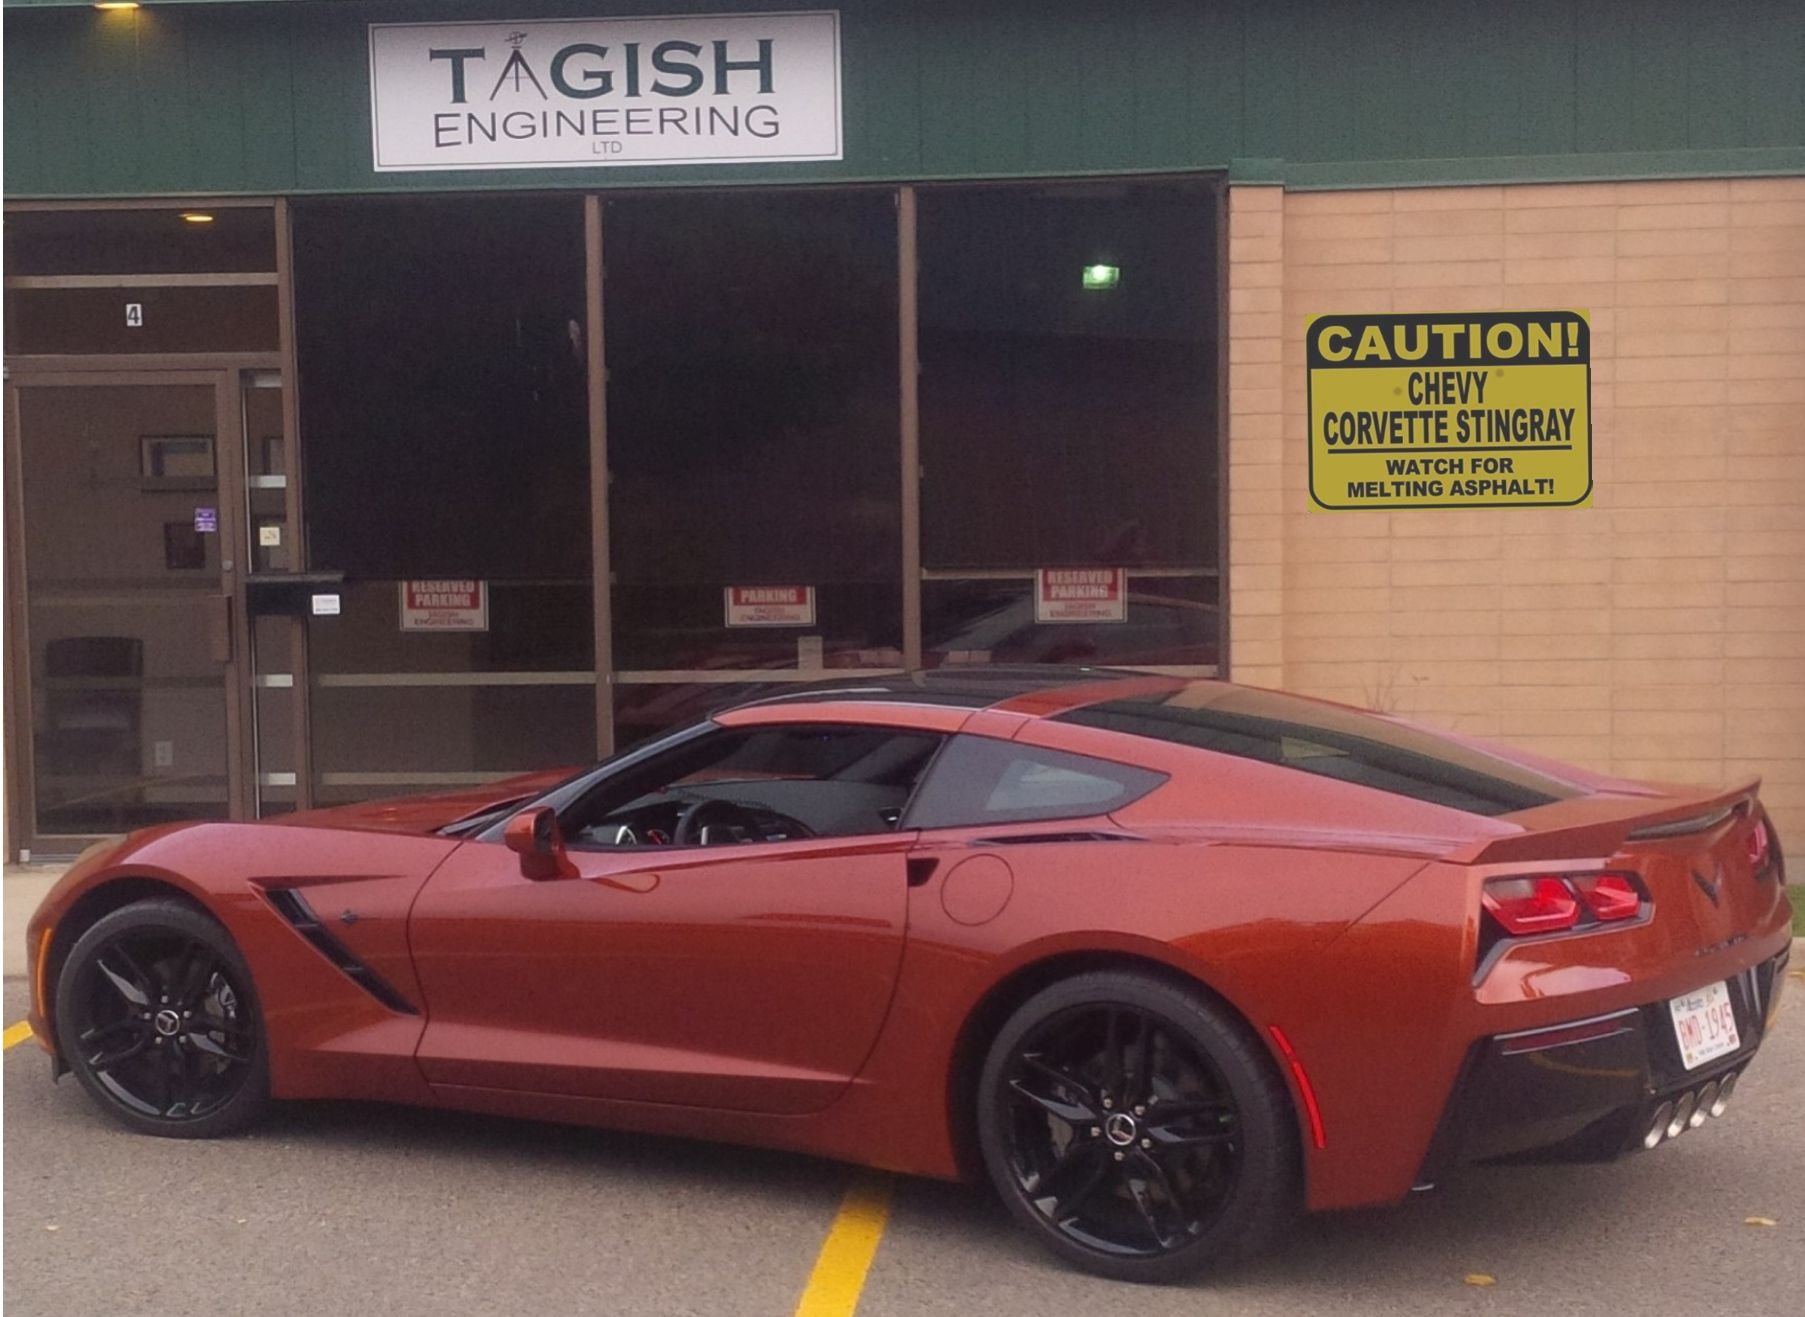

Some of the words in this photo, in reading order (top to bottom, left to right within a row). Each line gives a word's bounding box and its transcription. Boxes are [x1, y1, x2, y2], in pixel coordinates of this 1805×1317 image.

[429, 34, 775, 104] TAGISH
[434, 105, 780, 148] ENGINEERING
[592, 141, 623, 155] LTD
[127, 305, 140, 325] 4
[1318, 322, 1579, 362] CAUTION!
[1408, 371, 1488, 405] CHEVY
[1323, 410, 1448, 446] CORVETTE
[1456, 408, 1575, 443] STINGRAY
[1386, 459, 1463, 475] WATCH
[1471, 457, 1514, 474] FOR
[1347, 481, 1443, 498] MELTING
[1450, 479, 1555, 496] ASPHALT!
[1047, 570, 1113, 584] RESERVED
[415, 593, 471, 606] PARKING
[740, 589, 798, 603] PARKING
[1050, 584, 1109, 598] PARKING
